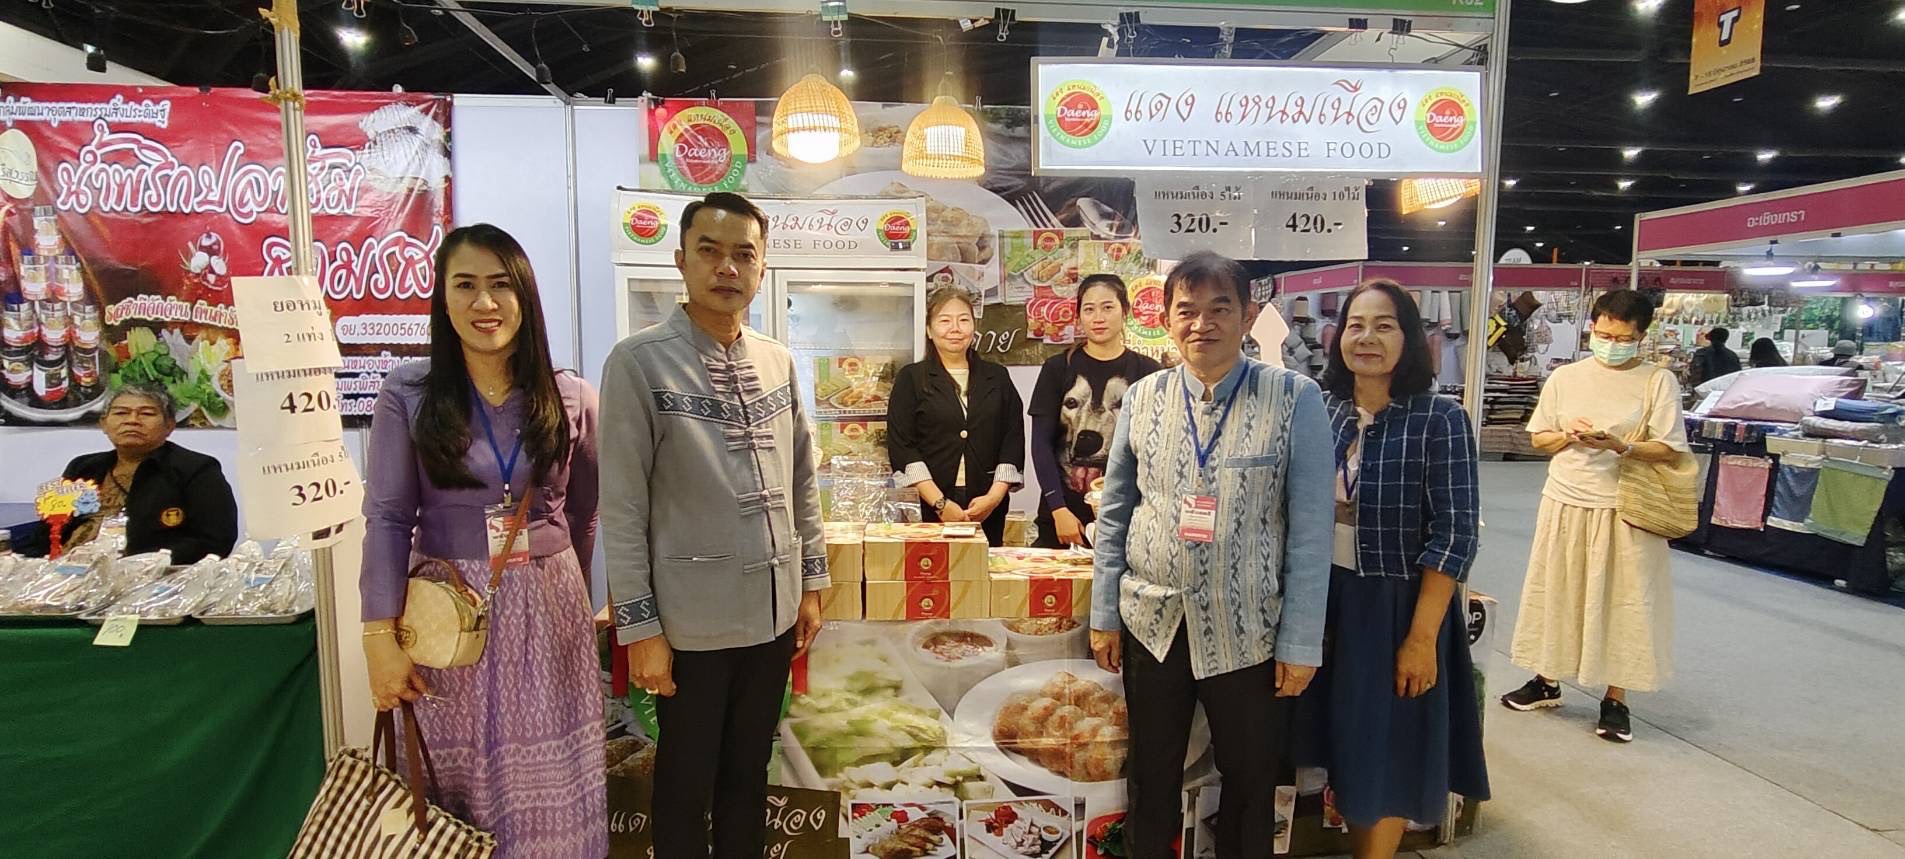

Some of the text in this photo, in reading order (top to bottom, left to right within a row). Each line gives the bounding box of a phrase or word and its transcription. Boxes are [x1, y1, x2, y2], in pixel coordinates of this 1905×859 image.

[1718, 7, 1741, 46] T
[1057, 105, 1098, 120] Daeng
[1124, 79, 1408, 133] แดง แหนมเนือง
[1426, 112, 1465, 126] Daeng
[674, 143, 728, 162] Daeng
[1142, 139, 1392, 159] VIETNAMESE FOOD
[1154, 185, 1242, 200] แหนมเนือง 5ไม้
[1271, 186, 1360, 200] แหนมเนือง 10ไม้
[632, 218, 657, 228] Daeng
[768, 208, 869, 236] นมเนือง
[1169, 213, 1229, 233] 320.-
[1285, 212, 1343, 233] 420.-
[1747, 210, 1805, 228] ฉะเชิงเทรา
[884, 223, 910, 234] Daeng
[770, 239, 858, 250] ESE FOOD
[272, 299, 323, 316] ยอหมู
[1134, 297, 1165, 311] Daen
[284, 333, 292, 343] 2
[296, 326, 324, 342] แท่ง
[338, 394, 375, 412] โทร.08
[262, 452, 335, 475] แหนมเนือง
[289, 478, 351, 506] 320.-
[610, 810, 648, 833] แด
[765, 795, 826, 835] นือง
